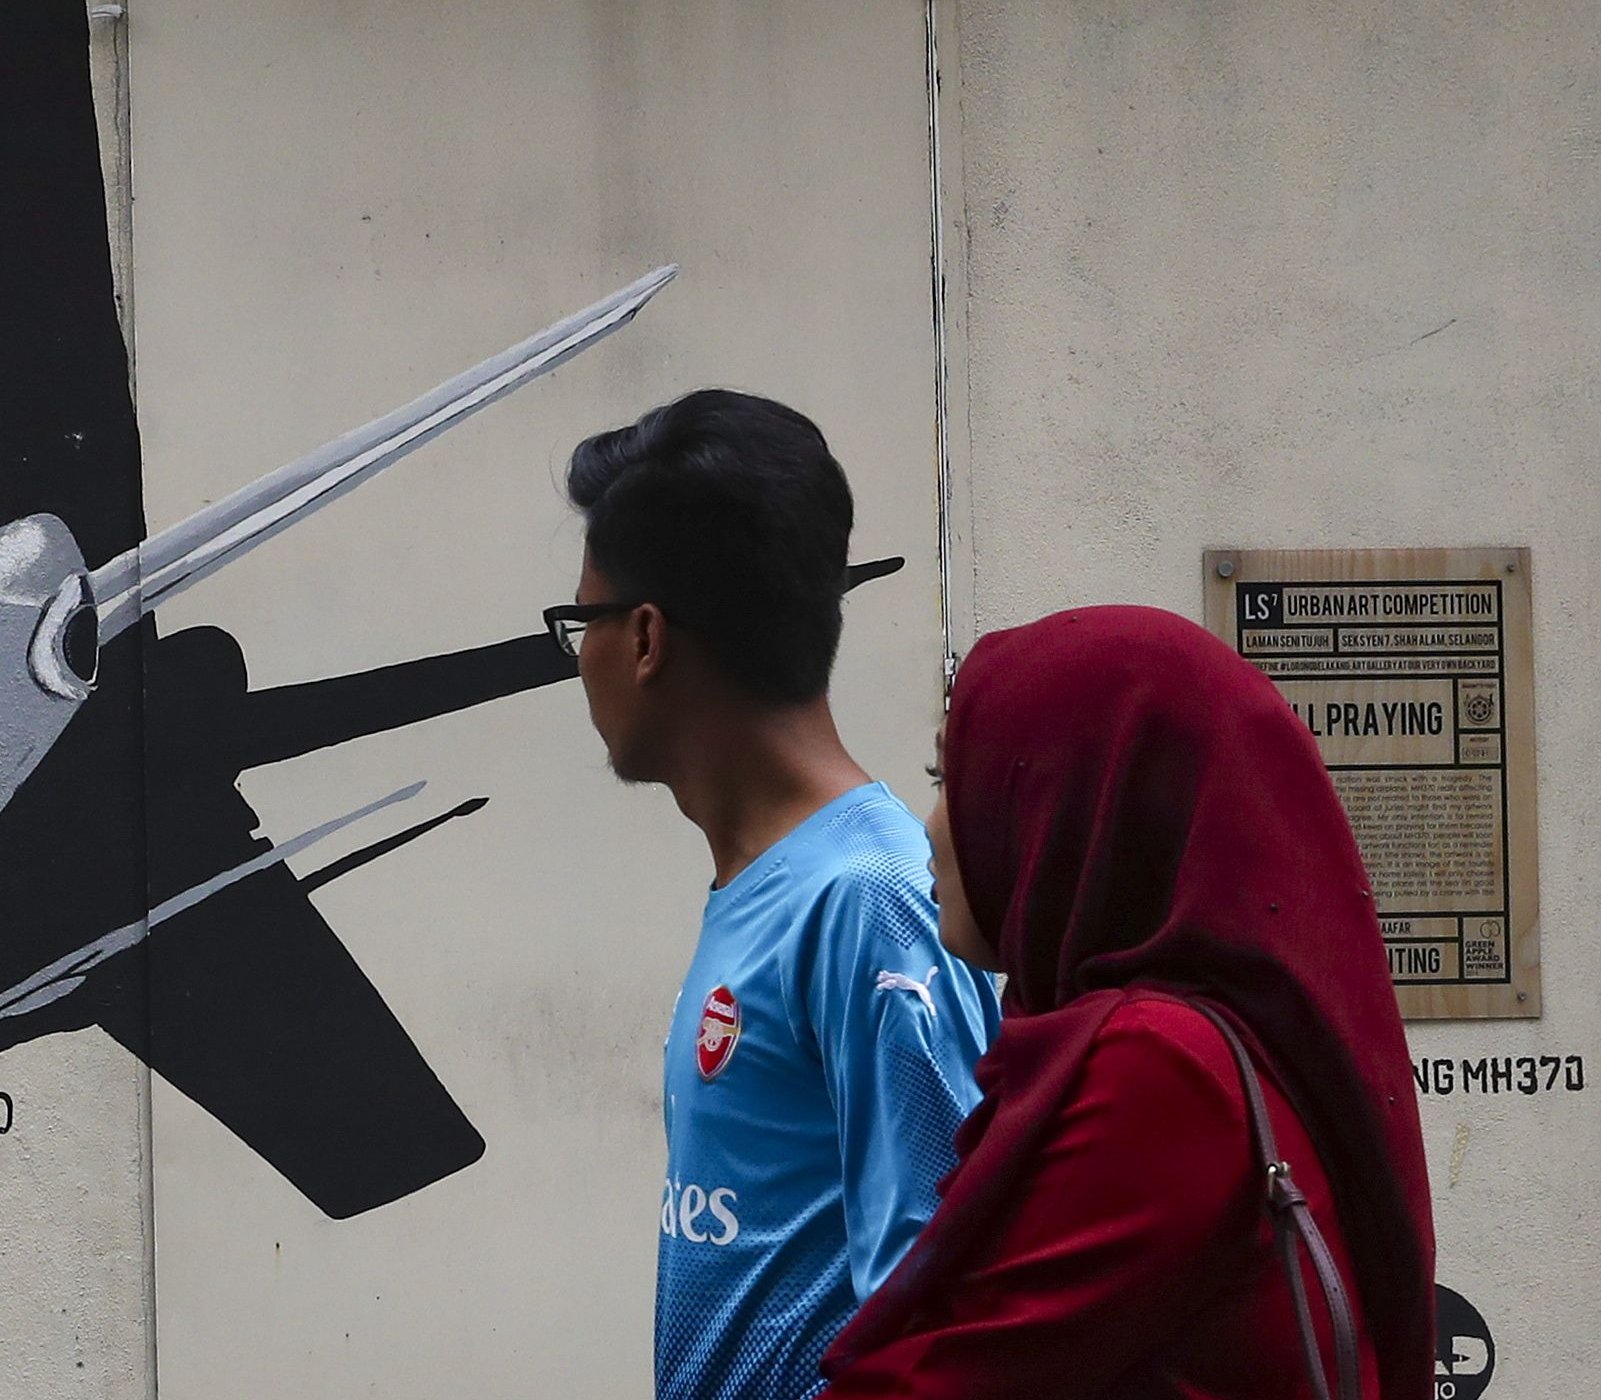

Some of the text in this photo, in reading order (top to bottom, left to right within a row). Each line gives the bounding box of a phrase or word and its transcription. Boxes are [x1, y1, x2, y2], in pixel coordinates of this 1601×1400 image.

[1288, 595, 1344, 616] URBAN
[1347, 594, 1379, 615] ART
[1383, 594, 1492, 615] COMPETITION
[1247, 634, 1329, 647] LAMAN SENI TUJUH
[1341, 634, 1384, 647] SEKSYEN
[1394, 634, 1419, 646] SHAH
[1448, 633, 1495, 646] SELANGOR
[1326, 702, 1443, 736] PRAYING
[1462, 1055, 1584, 1095] MH370
